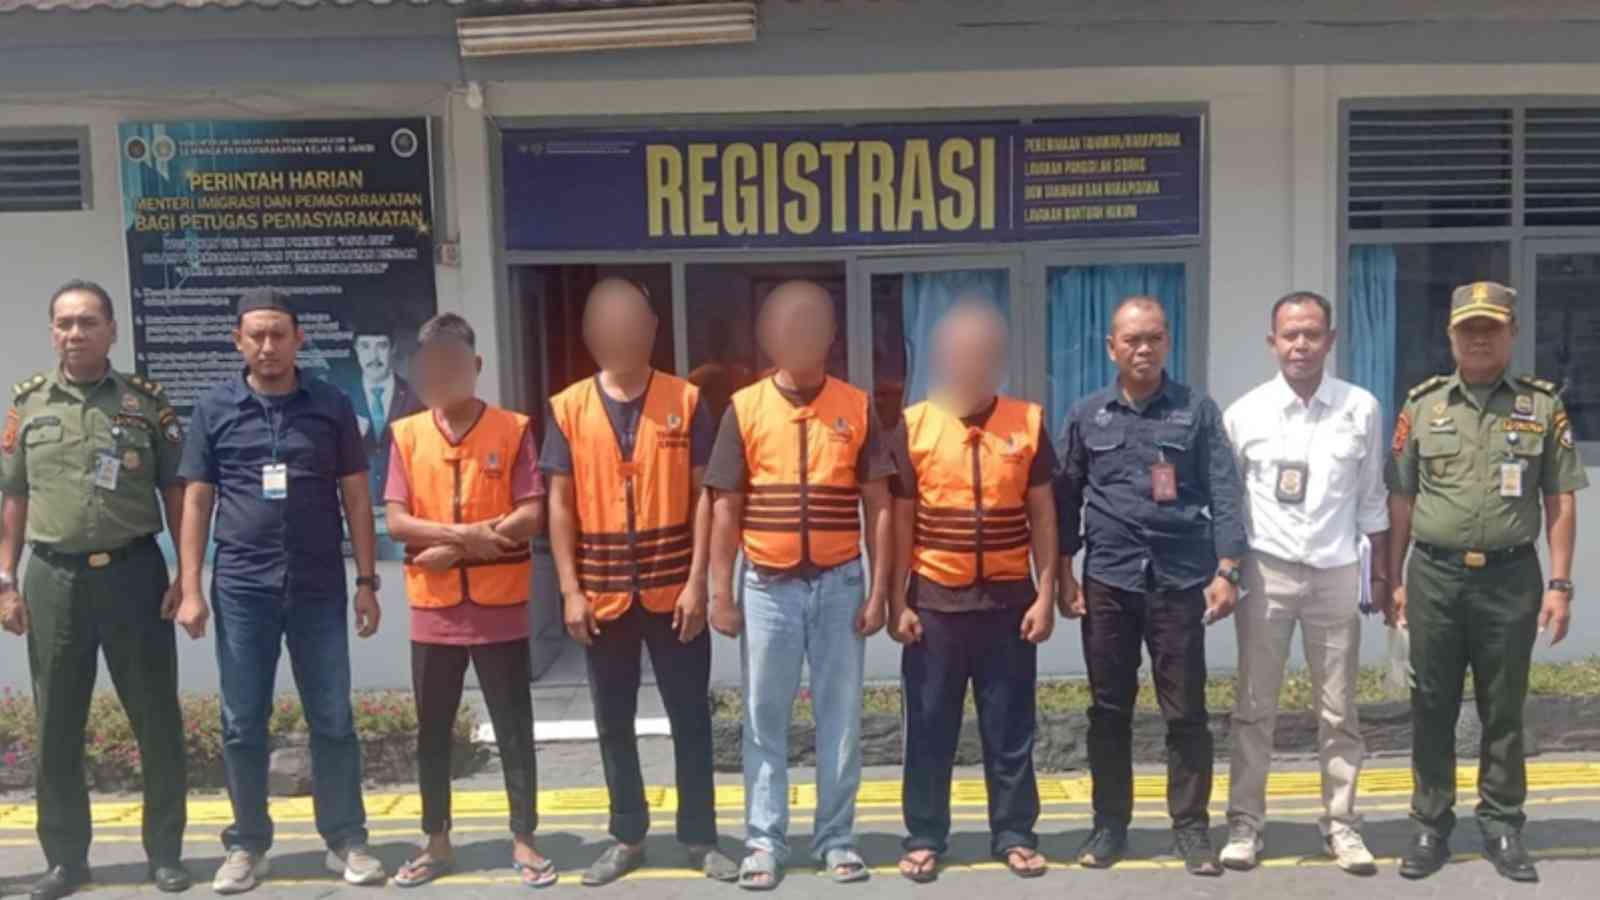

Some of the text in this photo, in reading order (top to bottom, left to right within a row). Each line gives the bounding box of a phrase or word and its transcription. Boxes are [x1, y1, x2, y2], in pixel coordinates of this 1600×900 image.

[191, 170, 363, 192] PERINTAH HARIAN
[646, 137, 996, 236] REGISTRASI
[137, 193, 422, 210] MENTERI IMIGRASI DAN PEMASYARAKATAN
[136, 211, 424, 232] BAGI PETUGAS PEMASYARAKATAN
